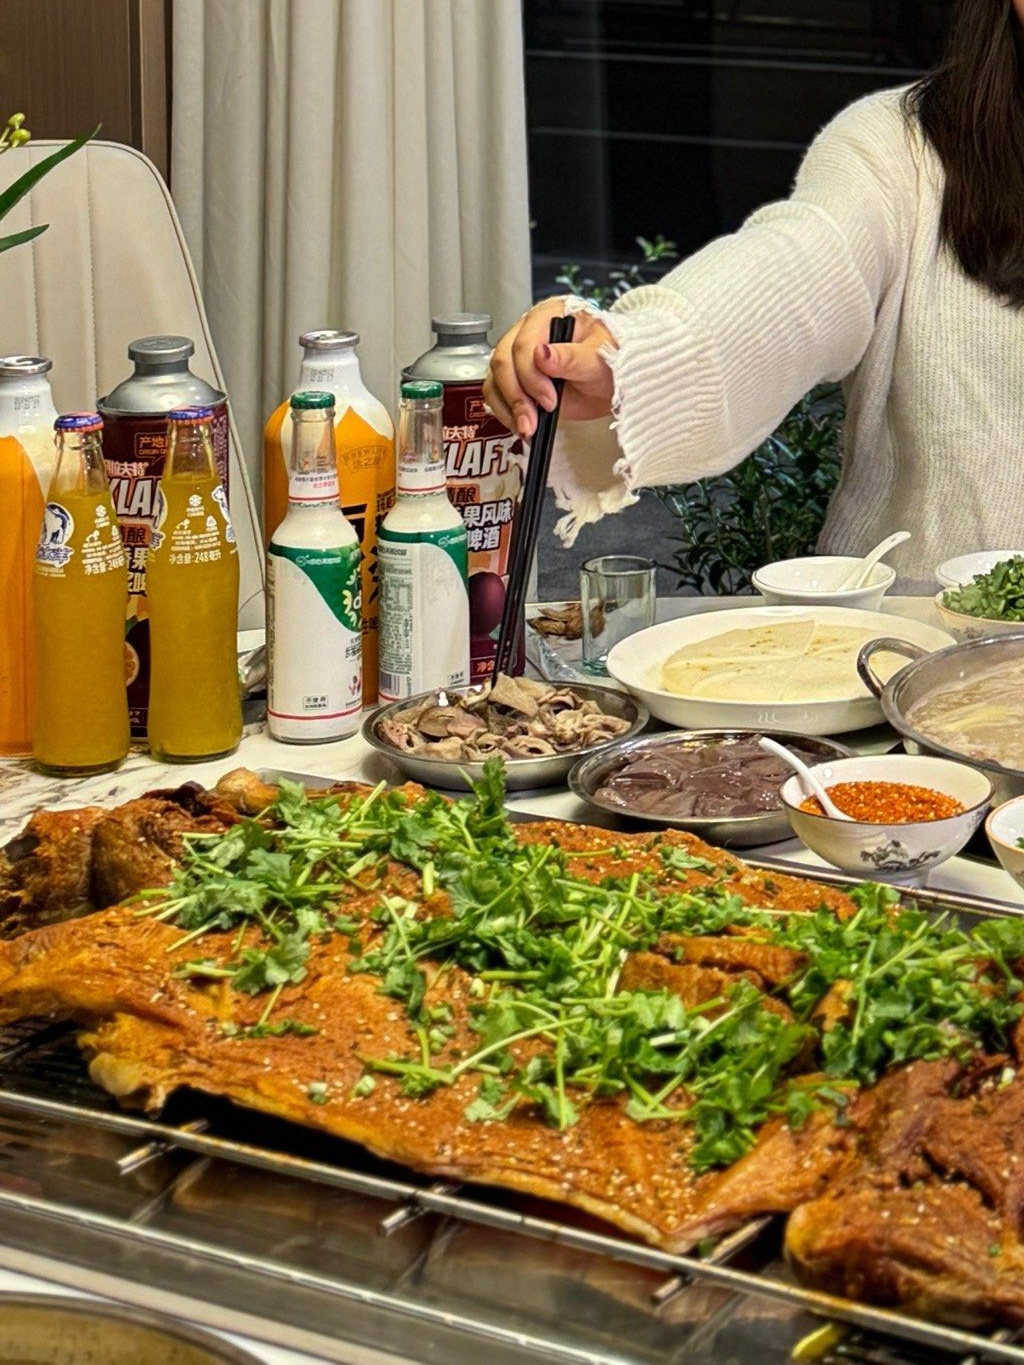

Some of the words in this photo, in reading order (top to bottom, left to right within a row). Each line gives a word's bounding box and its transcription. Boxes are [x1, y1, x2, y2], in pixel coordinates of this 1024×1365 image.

[139, 436, 168, 448] 产地
[444, 435, 517, 477] LAFT
[110, 477, 162, 516] LA
[457, 501, 513, 527] 果风味
[467, 526, 500, 550] 啤酒
